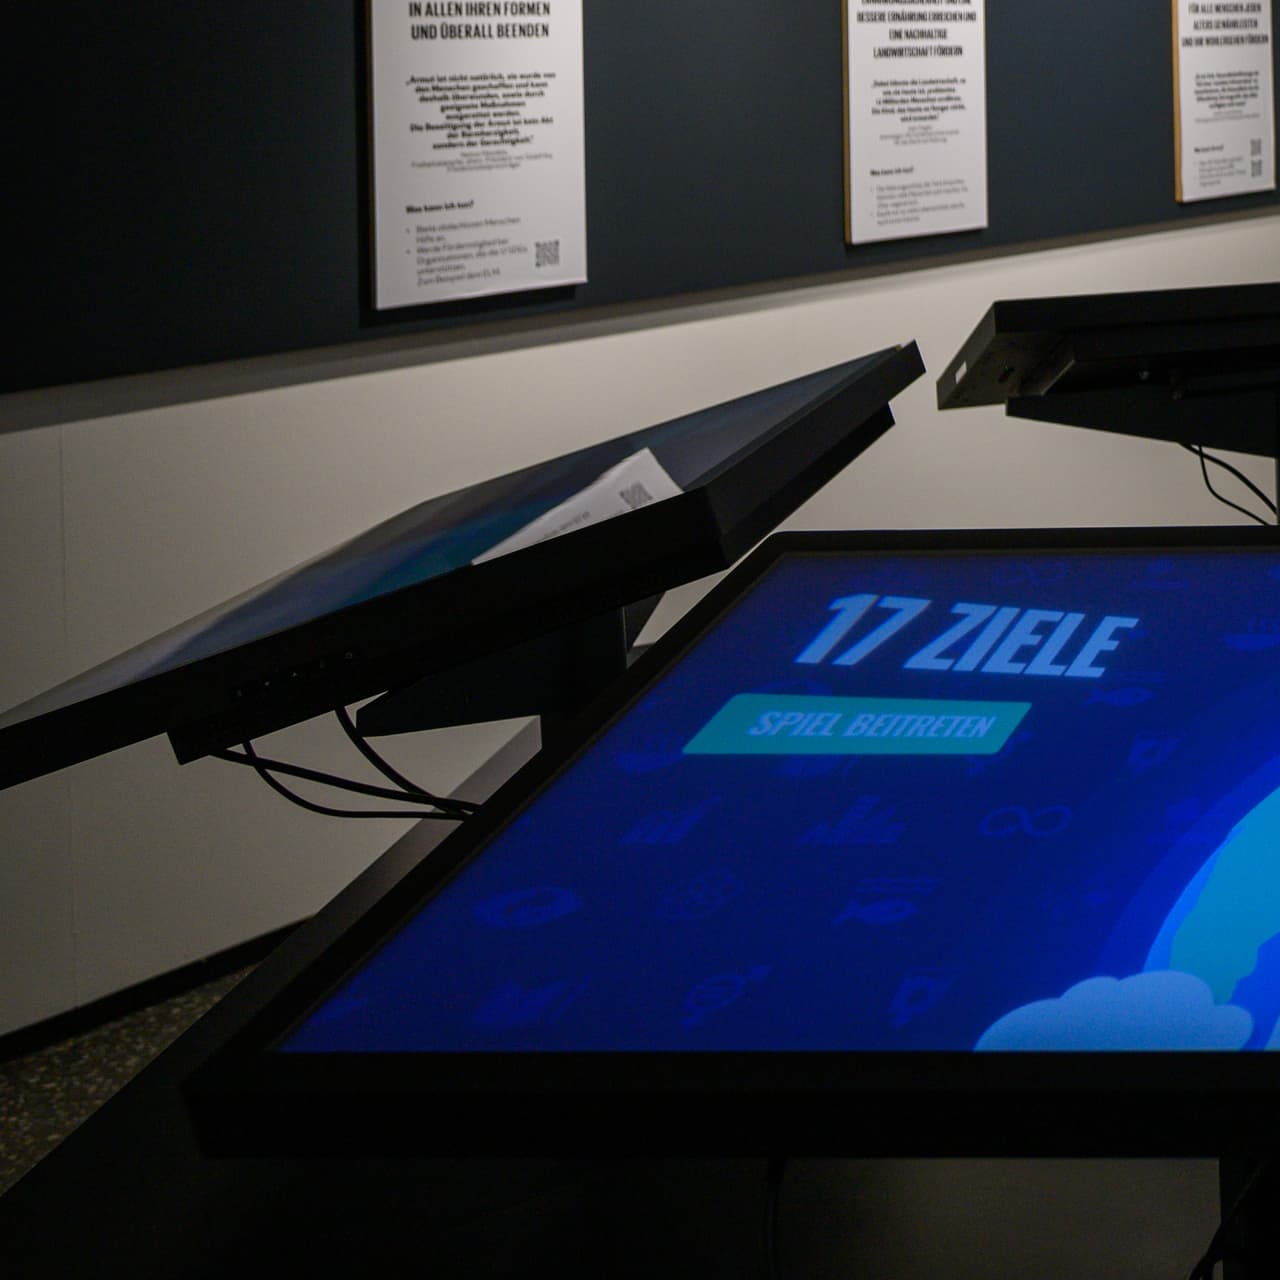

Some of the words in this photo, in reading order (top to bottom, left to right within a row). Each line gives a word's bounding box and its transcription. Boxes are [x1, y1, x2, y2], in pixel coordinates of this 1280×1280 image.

[408, 1, 422, 18] IN
[424, 1, 463, 18] ALLEN
[465, 1, 501, 17] IHREN
[503, 0, 551, 17] FORMEN
[411, 23, 438, 40] UND
[440, 21, 494, 40] ÜBERALL
[496, 21, 550, 39] BEENDEN
[795, 592, 931, 667] 17
[904, 602, 1139, 678] ZIELE
[747, 710, 843, 738] SPIEL
[843, 713, 997, 739] BEITRETEN
